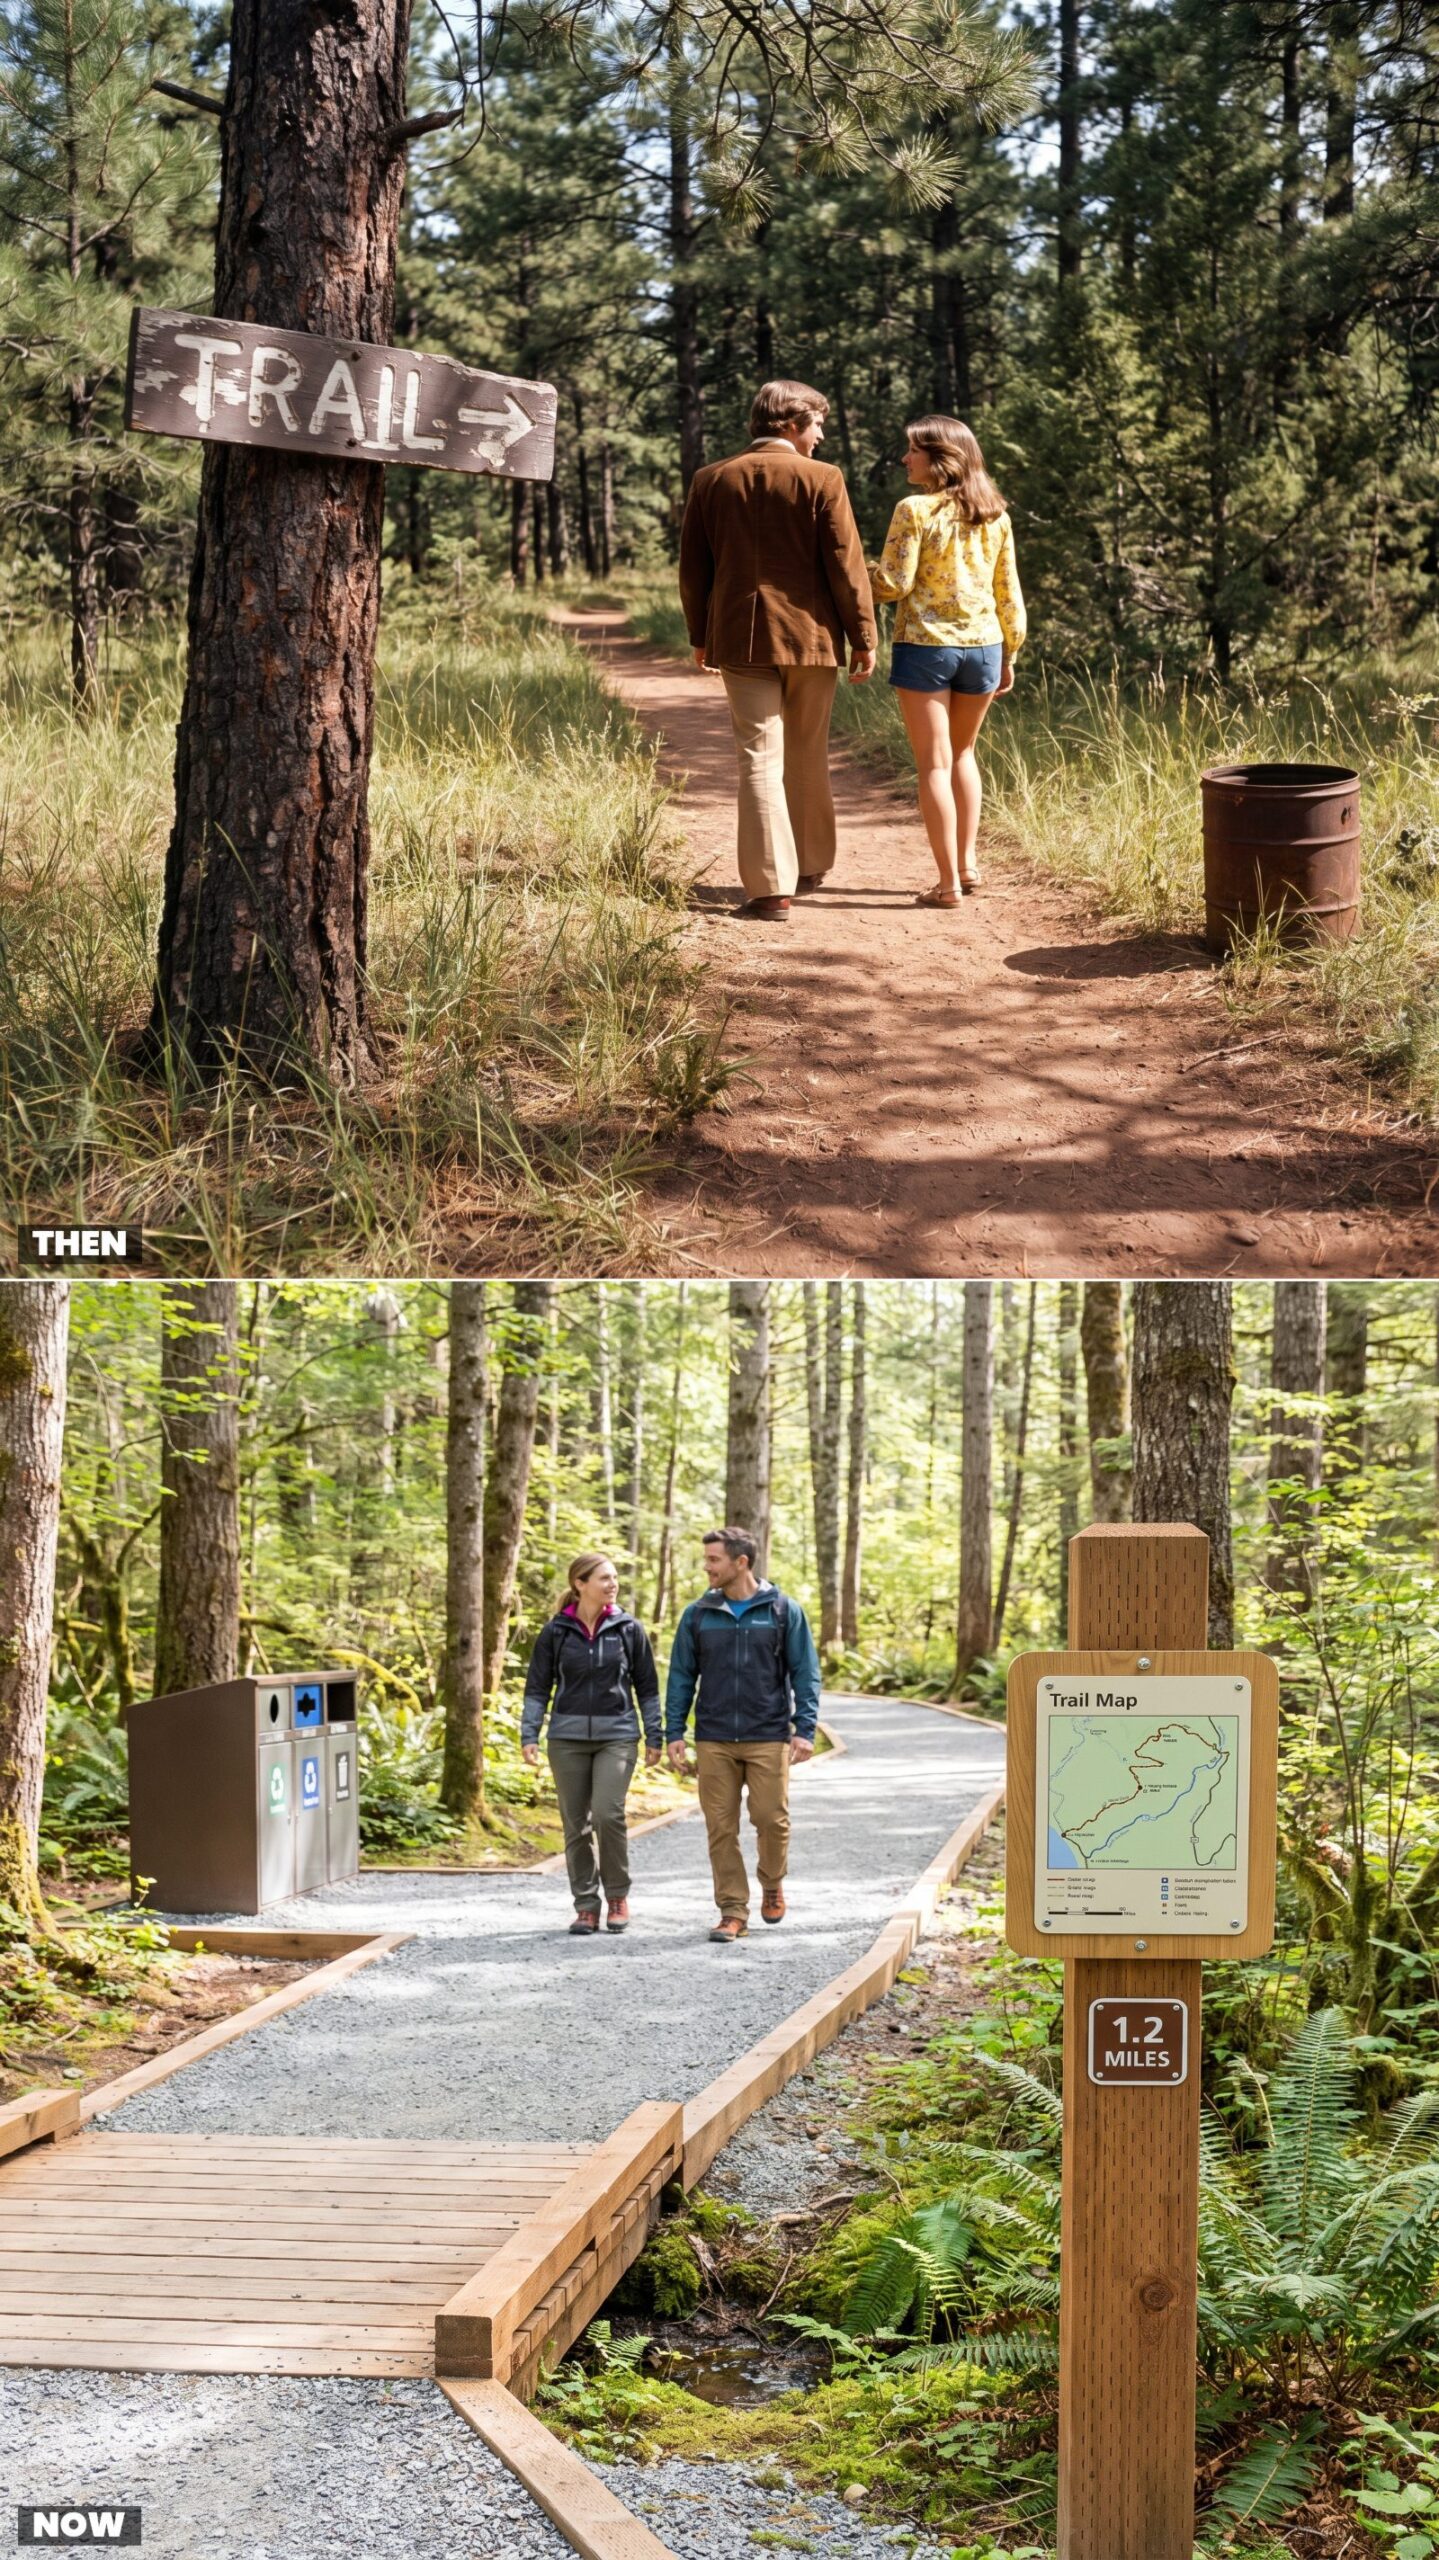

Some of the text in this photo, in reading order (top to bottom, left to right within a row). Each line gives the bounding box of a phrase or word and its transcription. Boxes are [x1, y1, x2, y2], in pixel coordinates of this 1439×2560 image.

[174, 333, 447, 451] TRAIL
[1049, 1692, 1138, 1711] Trail Map
[1112, 2016, 1164, 2044] 1.2
[1105, 2050, 1170, 2068] MILES
